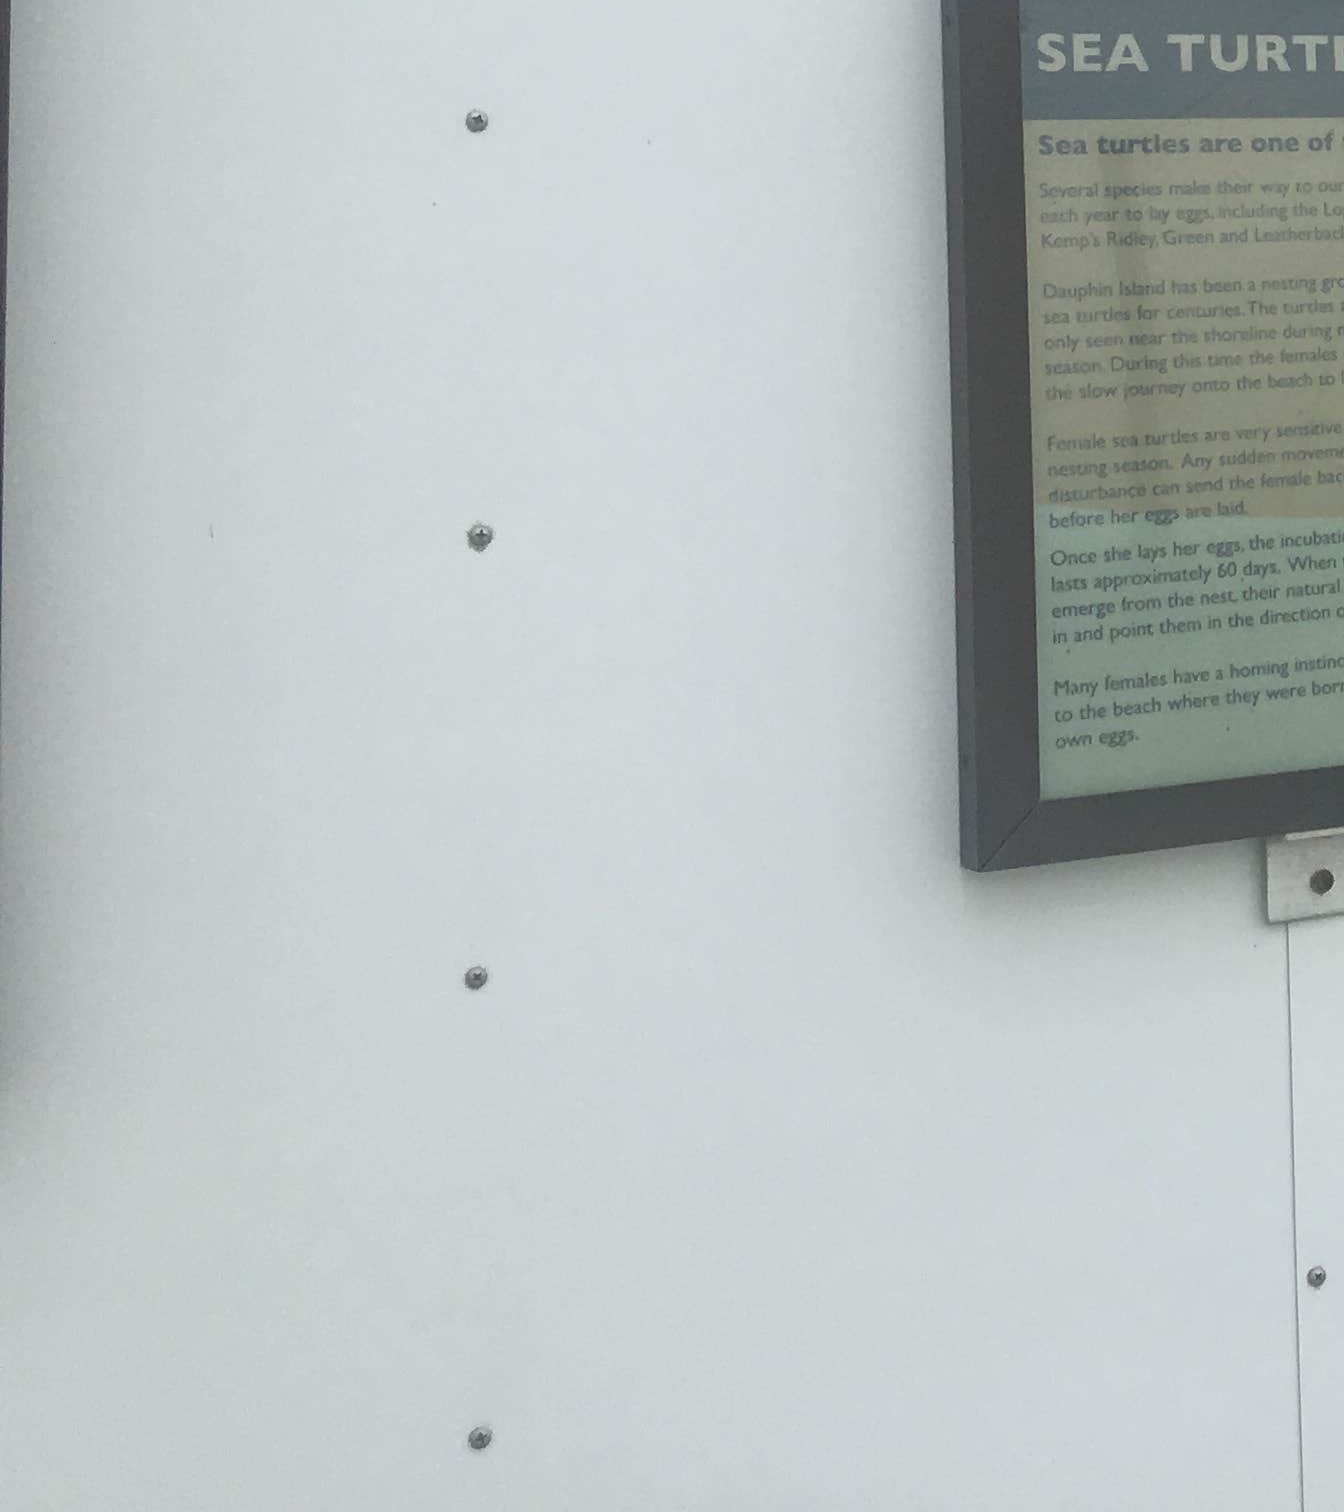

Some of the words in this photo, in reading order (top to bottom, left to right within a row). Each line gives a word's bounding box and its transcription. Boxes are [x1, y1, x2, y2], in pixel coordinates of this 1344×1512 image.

[1036, 32, 1149, 72] SEA
[1037, 133, 1089, 156] Sea
[1095, 133, 1190, 156] turtles
[1199, 137, 1243, 154] are
[1250, 136, 1299, 153] one
[1307, 130, 1335, 152] of
[1049, 549, 1098, 567] Once
[1102, 545, 1133, 564] she
[1136, 543, 1168, 564] lays
[1171, 540, 1199, 557] her
[1247, 533, 1275, 552] the
[1050, 575, 1088, 593] lasts
[1092, 563, 1213, 593] approximately
[1216, 560, 1238, 579] 60
[1286, 554, 1338, 572] When
[1049, 601, 1117, 621] emerge
[1119, 595, 1163, 612] from
[1166, 591, 1196, 609] the
[1240, 585, 1281, 602] their
[1284, 577, 1342, 598] natural
[1051, 629, 1069, 645] in
[1072, 623, 1105, 643] and
[1108, 622, 1155, 644] point
[1158, 616, 1203, 635] them
[1206, 615, 1222, 630] in
[1227, 612, 1255, 628] the
[1258, 607, 1332, 625] direction
[1052, 679, 1099, 698] Many
[1103, 671, 1169, 692] females
[1172, 667, 1210, 684] have
[1214, 668, 1224, 681] a
[1228, 661, 1291, 679] homing
